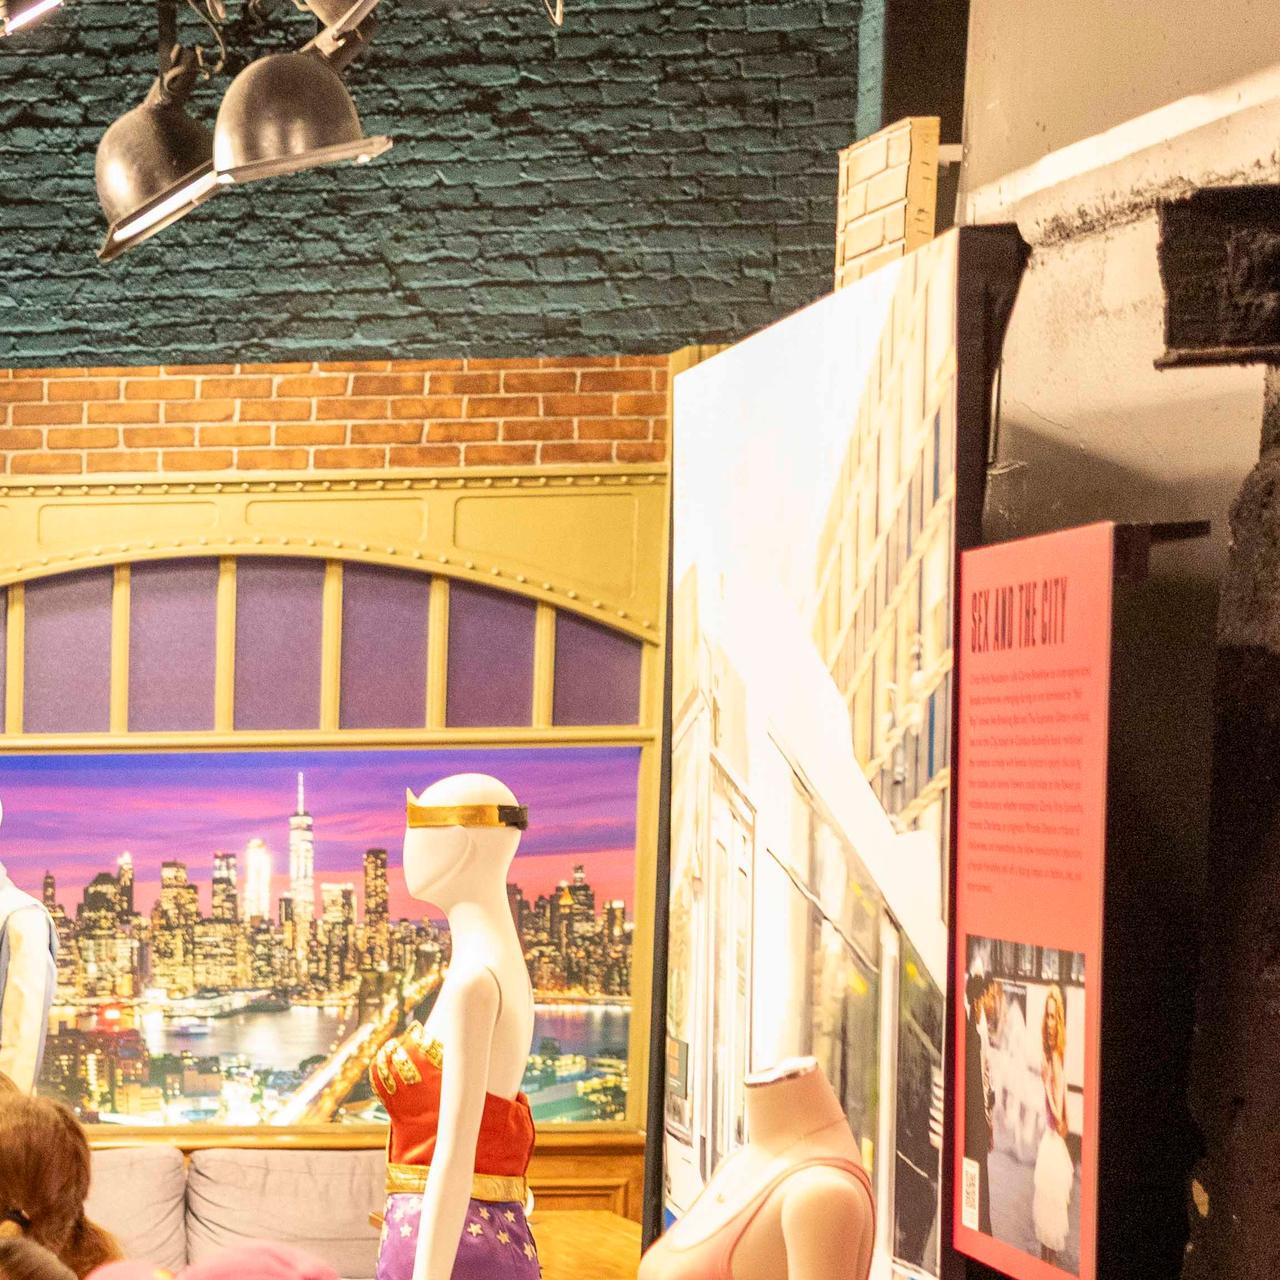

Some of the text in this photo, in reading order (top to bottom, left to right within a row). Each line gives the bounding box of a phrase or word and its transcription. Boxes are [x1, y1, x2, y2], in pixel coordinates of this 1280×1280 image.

[972, 577, 1067, 653] SEX AND THE CITY
